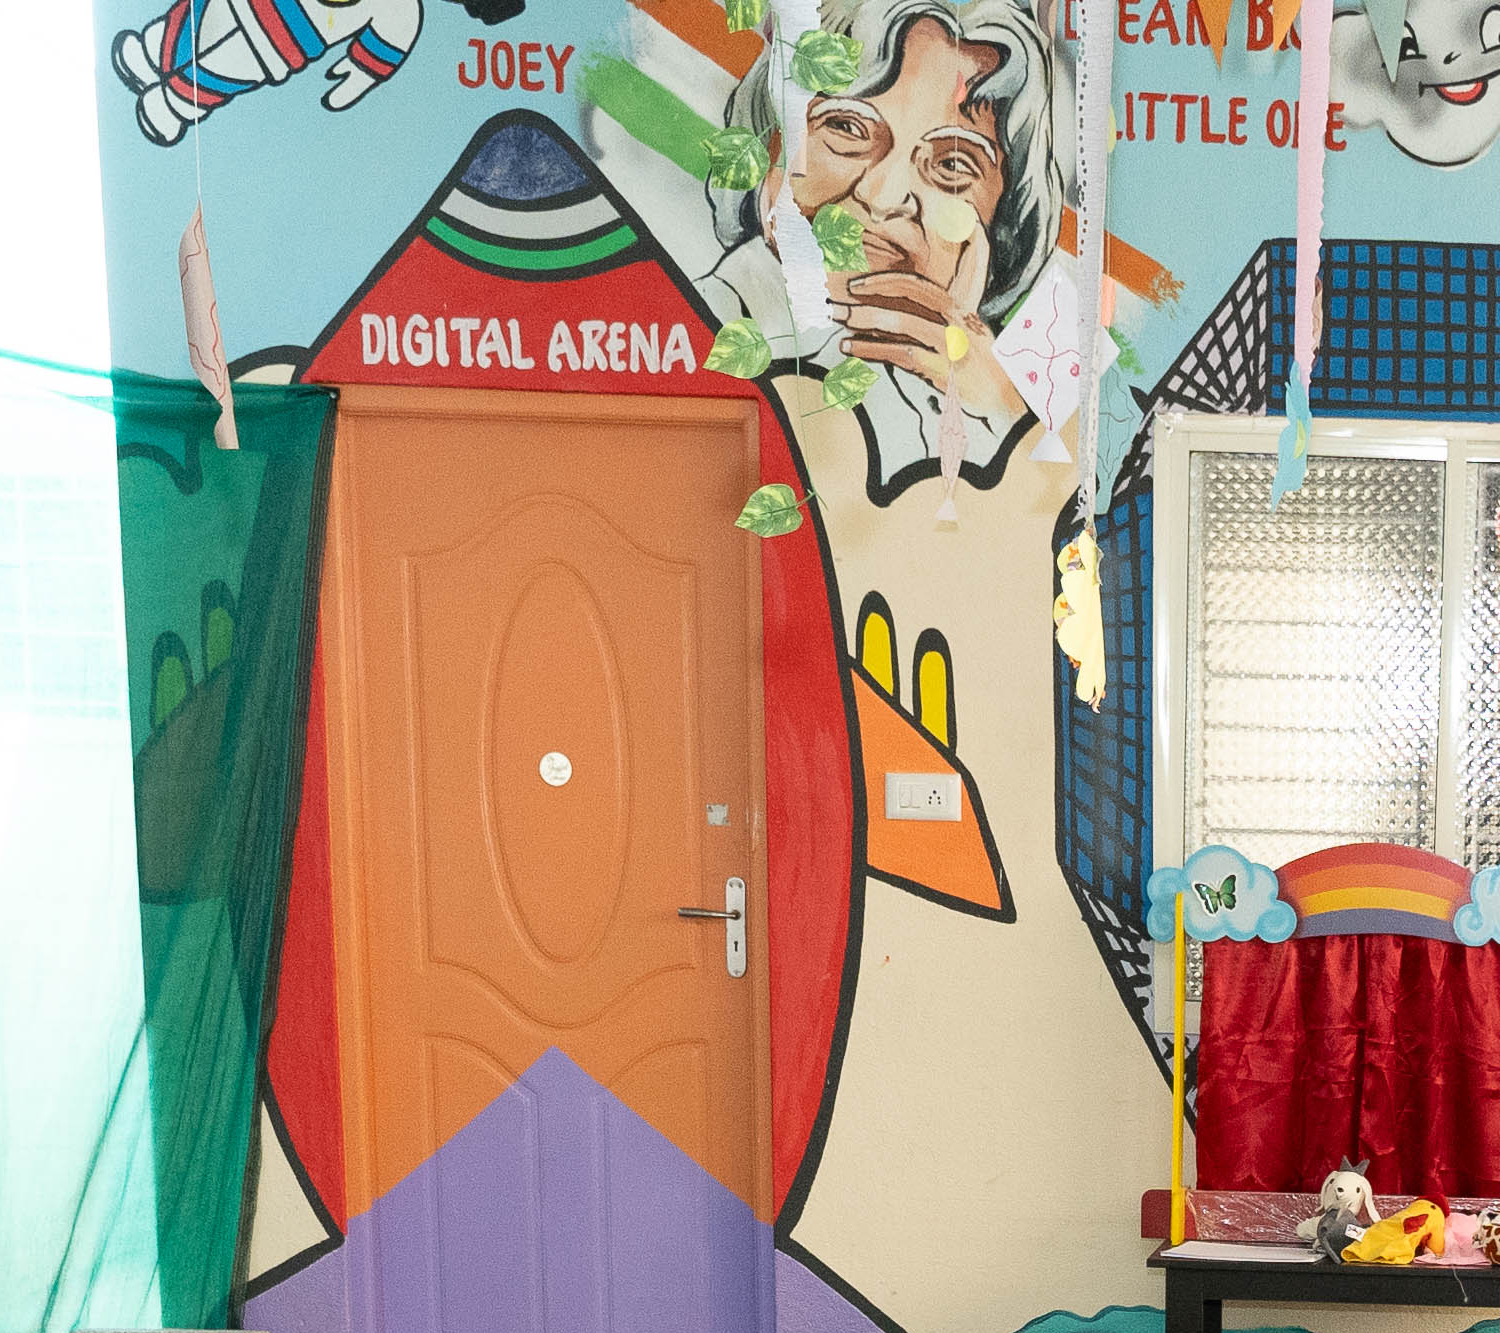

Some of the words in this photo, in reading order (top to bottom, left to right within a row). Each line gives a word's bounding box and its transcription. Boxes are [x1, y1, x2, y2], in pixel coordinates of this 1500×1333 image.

[458, 38, 574, 94] JOEY
[1115, 91, 1248, 146] ITTLE
[360, 313, 536, 370] DIGITAL
[547, 319, 697, 374] ARENA
